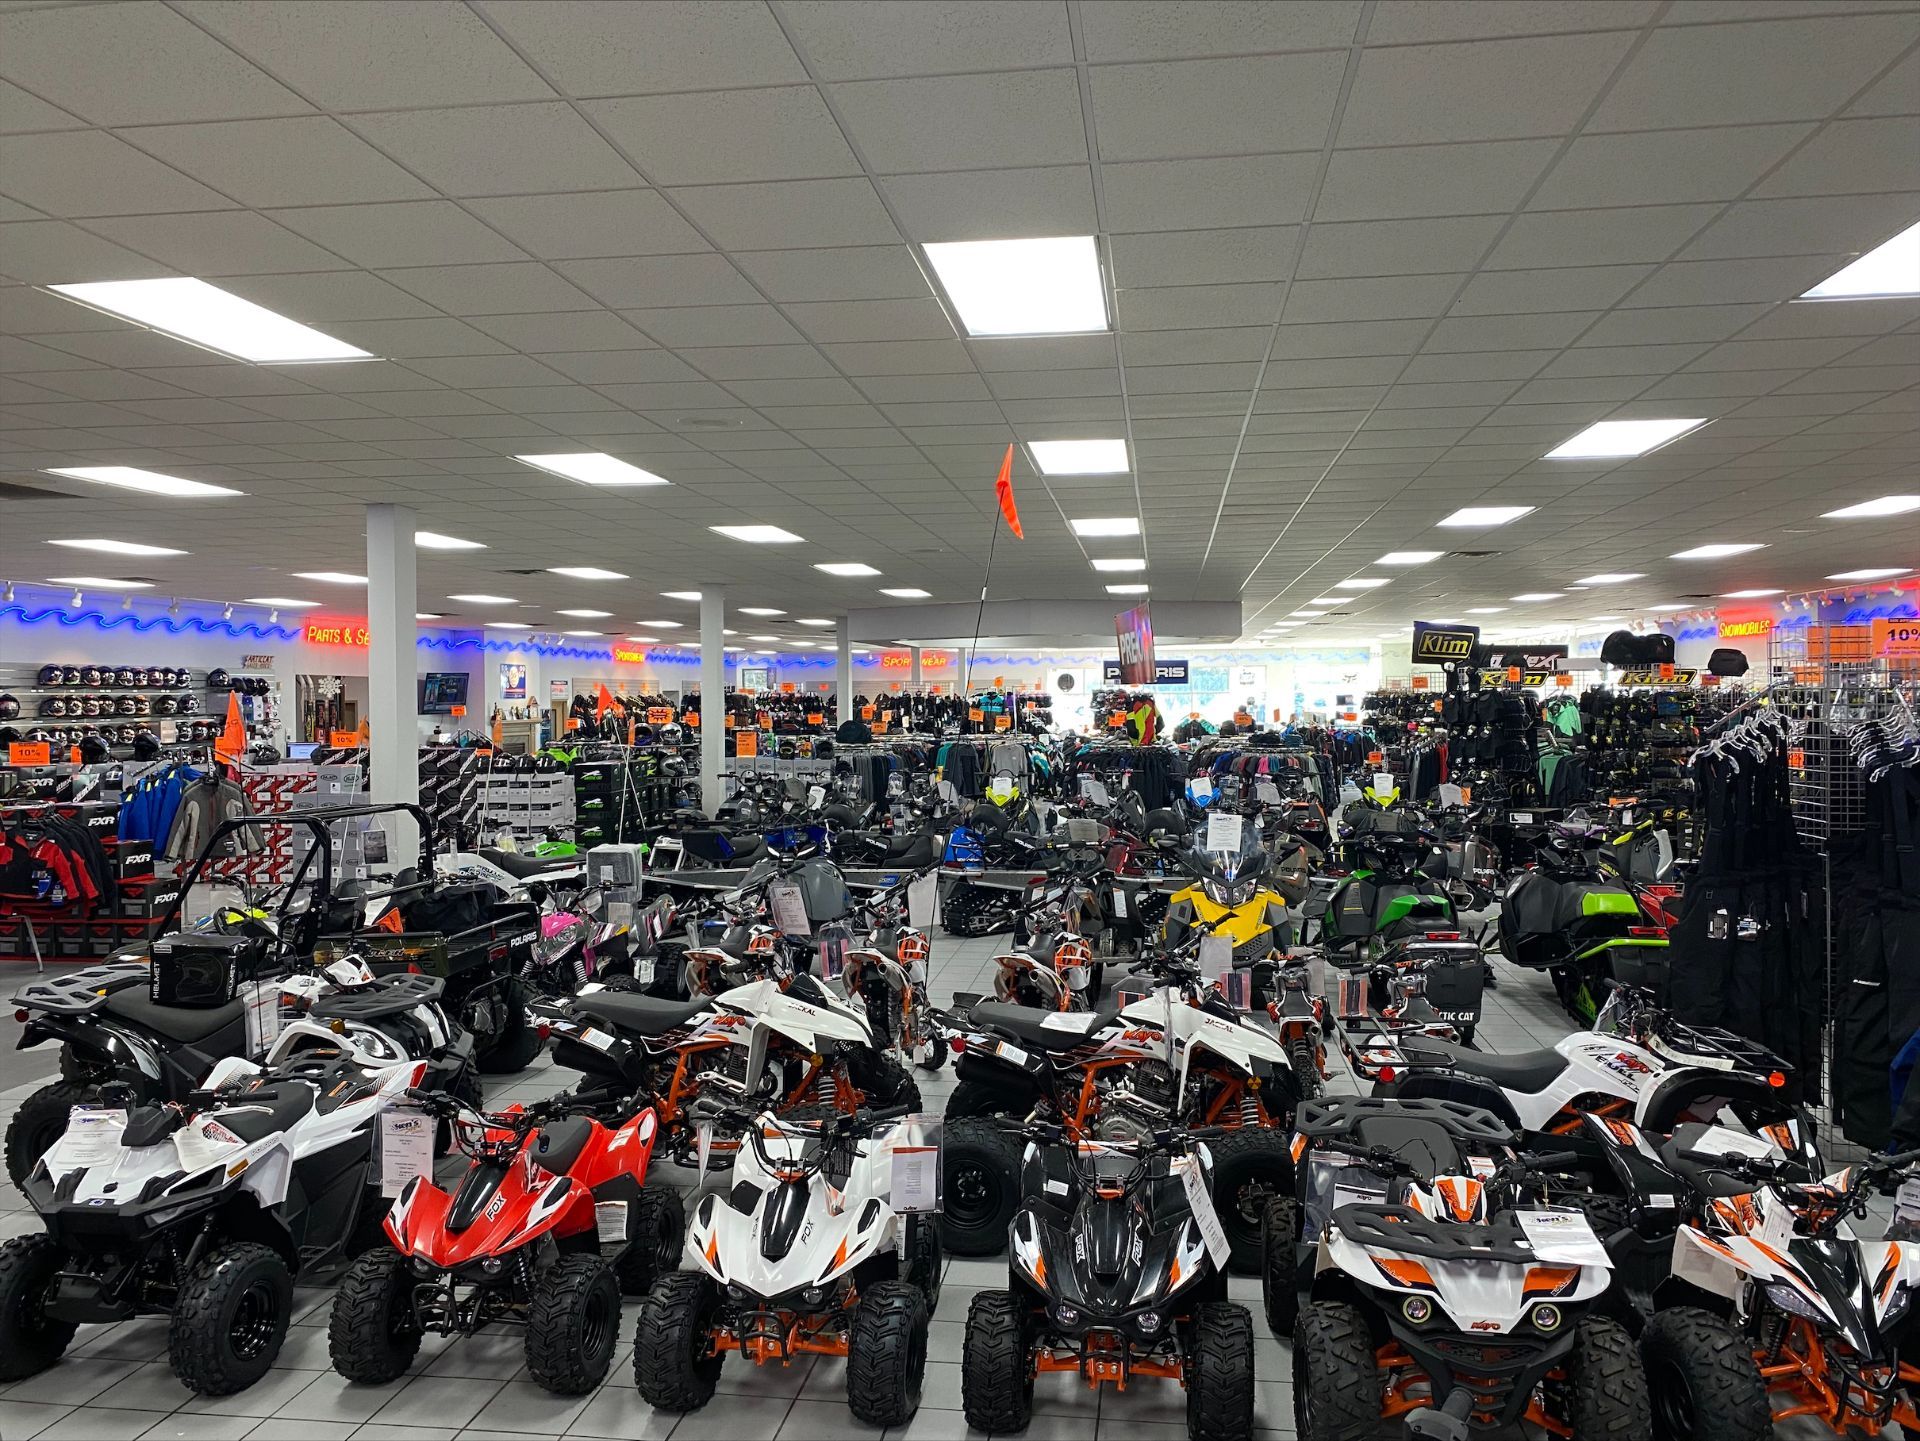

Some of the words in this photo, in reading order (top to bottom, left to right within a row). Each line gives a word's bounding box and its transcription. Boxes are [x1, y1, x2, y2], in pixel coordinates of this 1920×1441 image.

[308, 626, 341, 643] PARTS
[344, 628, 353, 645] &
[1719, 620, 1770, 638] SNOWMOBILES
[1421, 635, 1468, 654] Klim
[18, 748, 41, 757] 10%
[88, 816, 115, 827] FXR
[125, 853, 151, 865] FXR
[153, 892, 179, 904] FXR
[510, 931, 537, 948] POLARIS
[1457, 1012, 1475, 1021] CAT
[486, 1194, 507, 1222] FOX
[800, 1218, 814, 1246] FOX
[1074, 1232, 1086, 1263] FOX
[1131, 1234, 1144, 1268] FOX
